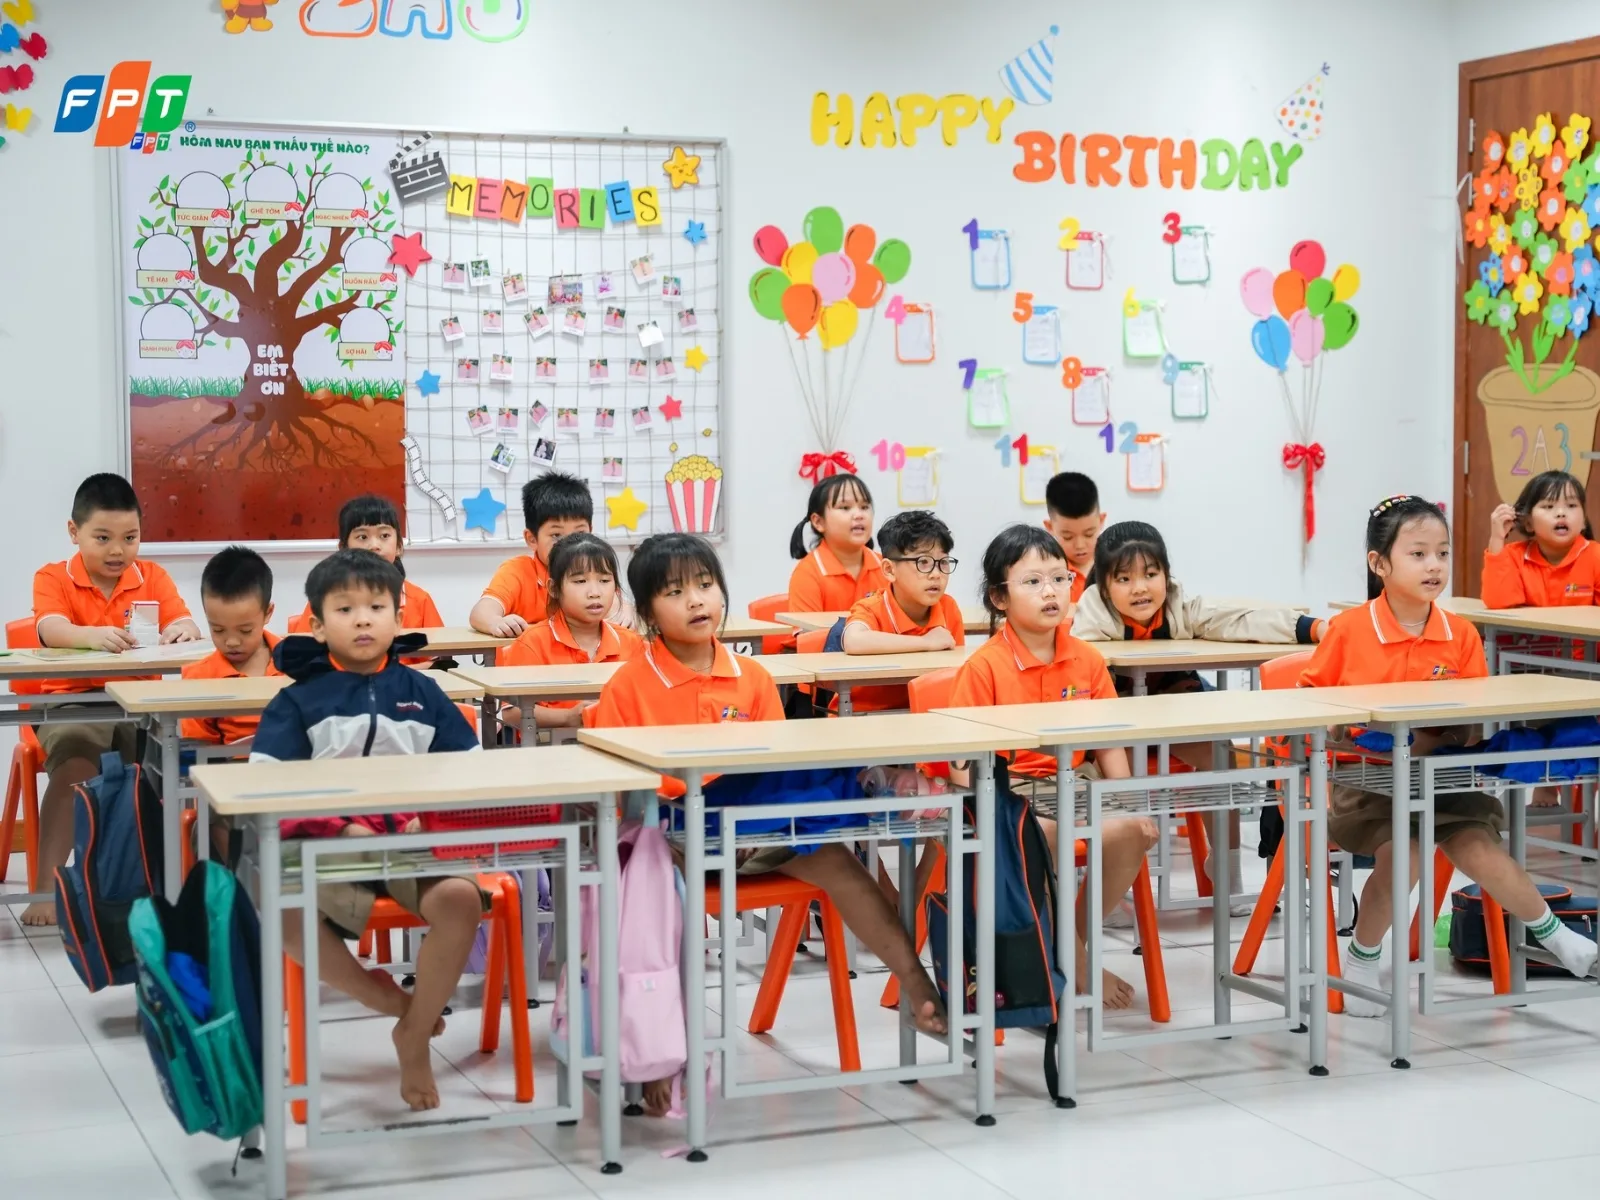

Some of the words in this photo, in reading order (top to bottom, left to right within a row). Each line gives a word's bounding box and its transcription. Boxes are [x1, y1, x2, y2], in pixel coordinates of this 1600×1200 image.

[809, 91, 1015, 149] HAPPY
[180, 134, 212, 147] HÔM
[245, 139, 271, 152] BẠN
[310, 137, 334, 153] THẾ
[337, 140, 370, 155] NÀO?
[1012, 130, 1303, 192] BIRTHDAY
[450, 180, 659, 224] MEMORIES
[962, 218, 979, 250] 1
[1058, 217, 1080, 250] 2
[1162, 212, 1182, 244] 3
[884, 295, 907, 324] 4
[1012, 292, 1033, 323] 5
[1123, 286, 1140, 318] 6
[253, 357, 289, 377] BIẾT
[257, 344, 284, 358] EM
[959, 358, 977, 389] 7
[1062, 357, 1082, 389] 8
[1162, 354, 1180, 386] 9
[260, 379, 285, 395] ƠN
[994, 433, 1029, 467] 11
[1099, 421, 1139, 454] 12
[1510, 423, 1573, 476] 2A3
[870, 439, 906, 471] 10
